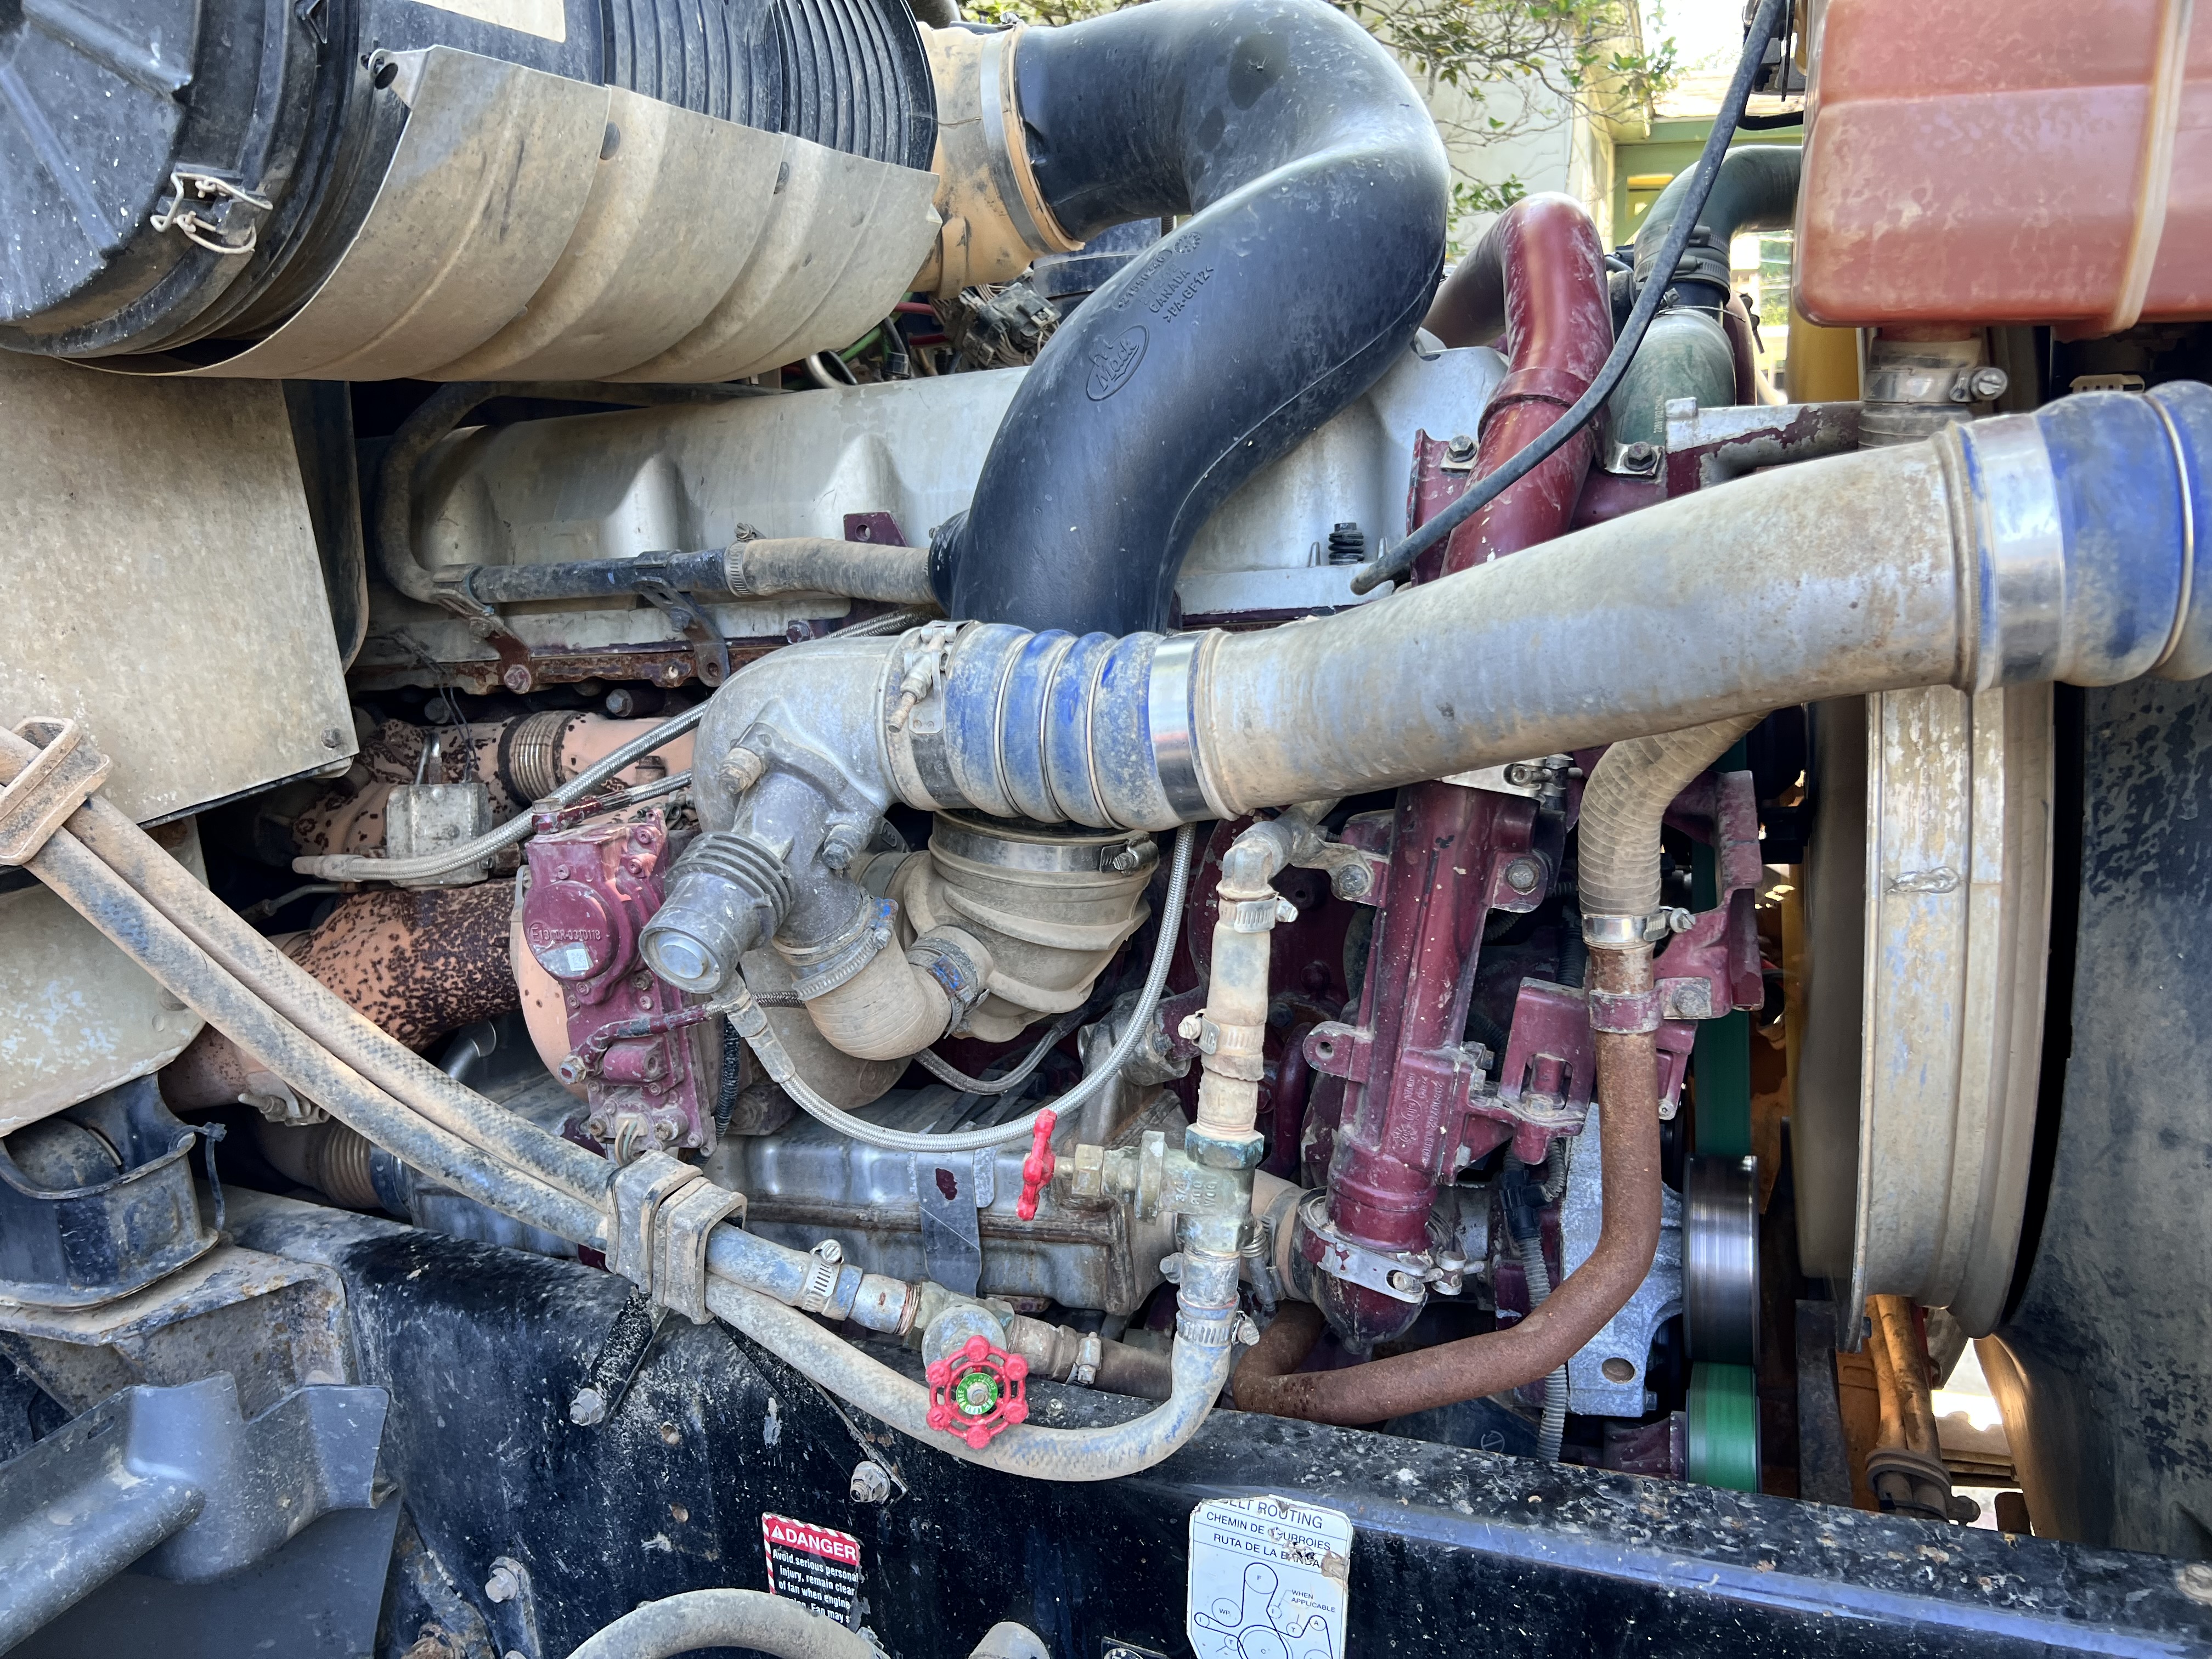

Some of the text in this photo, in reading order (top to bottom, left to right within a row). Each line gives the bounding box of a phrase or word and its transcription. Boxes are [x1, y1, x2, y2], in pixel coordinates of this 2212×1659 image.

[1149, 270, 1190, 313] CANADA
[1096, 338, 1139, 392] Mack
[957, 1389, 967, 1407] FREE
[964, 1404, 983, 1415] LEAD
[1206, 1511, 1248, 1530] CHEMIN
[1250, 1522, 1265, 1534] DE
[1257, 1501, 1323, 1529] ROUTING
[785, 1528, 857, 1561] DANGER
[1214, 1533, 1242, 1549] RUTA
[1245, 1541, 1260, 1553] DE
[1263, 1546, 1277, 1558] LA
[772, 1549, 859, 1583] Avoid serious personal
[780, 1565, 855, 1596] injury, remain clear
[778, 1580, 850, 1610] of fan when engine
[1291, 1589, 1313, 1599] WHEN
[1291, 1598, 1335, 1613] APPLICABLE
[811, 1602, 826, 1616] Fan
[827, 1610, 844, 1624] may
[1218, 1607, 1230, 1616] WP
